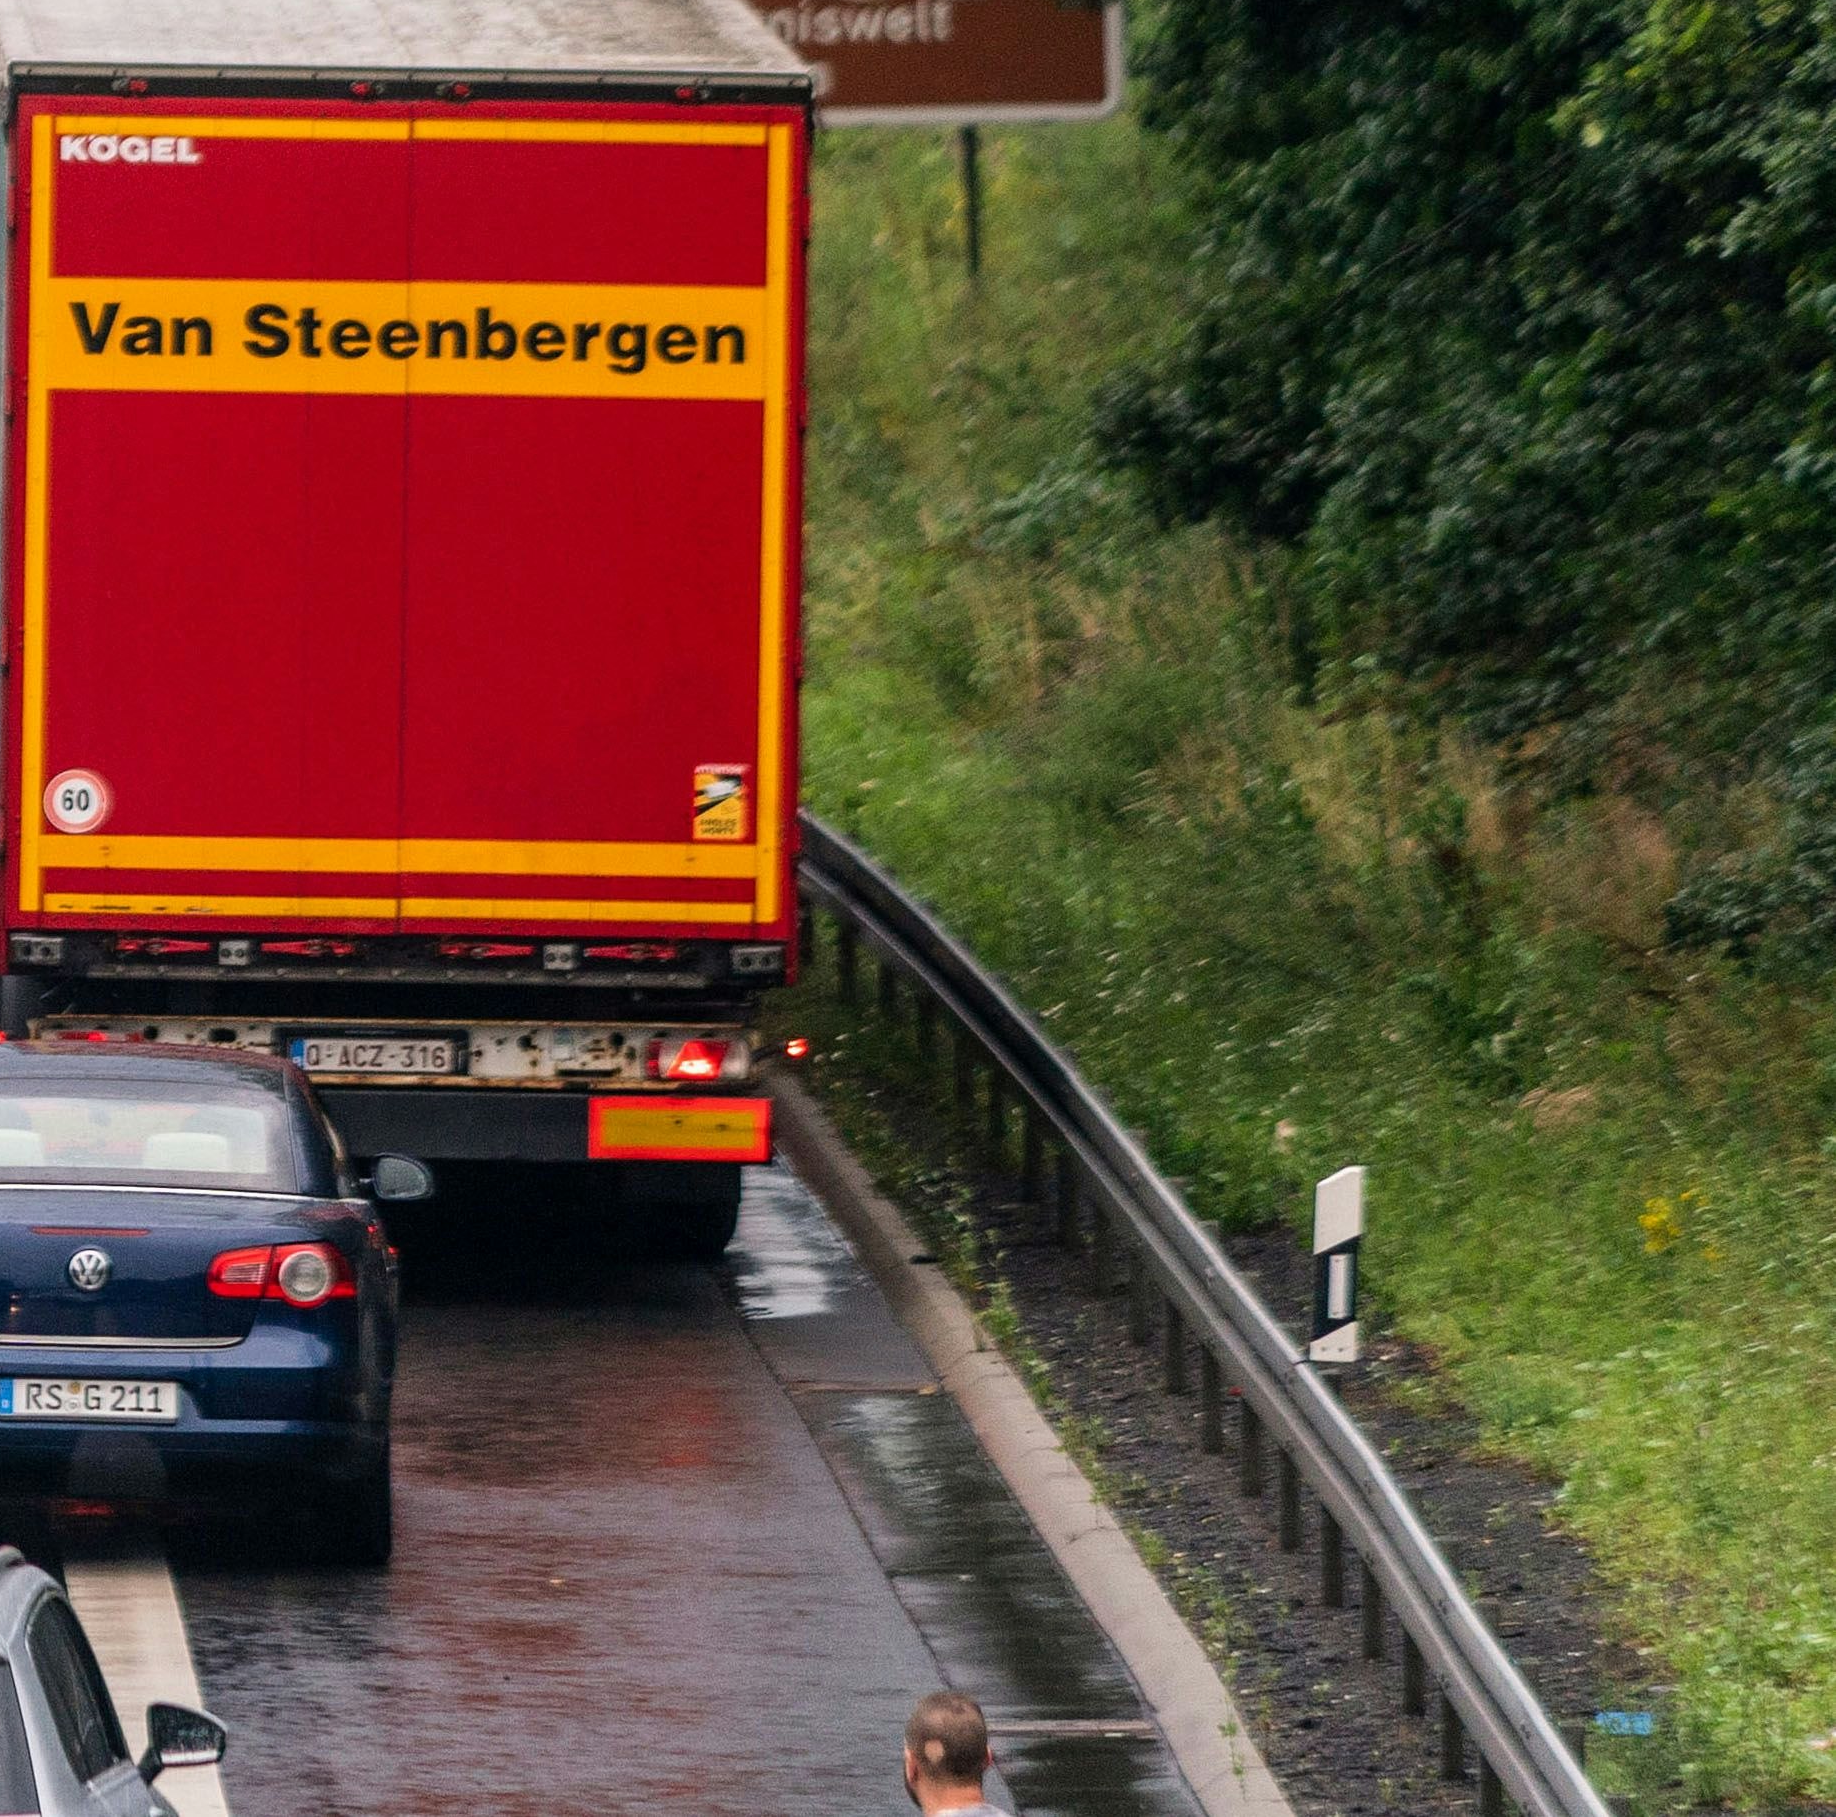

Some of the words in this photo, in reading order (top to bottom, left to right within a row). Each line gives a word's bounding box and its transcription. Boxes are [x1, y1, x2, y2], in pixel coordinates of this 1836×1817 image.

[69, 301, 213, 356] Van
[243, 303, 747, 375] Steenbergen
[62, 789, 90, 811] 60
[26, 1384, 63, 1410] RS
[84, 1384, 101, 1410] G
[110, 1386, 163, 1413] 211
